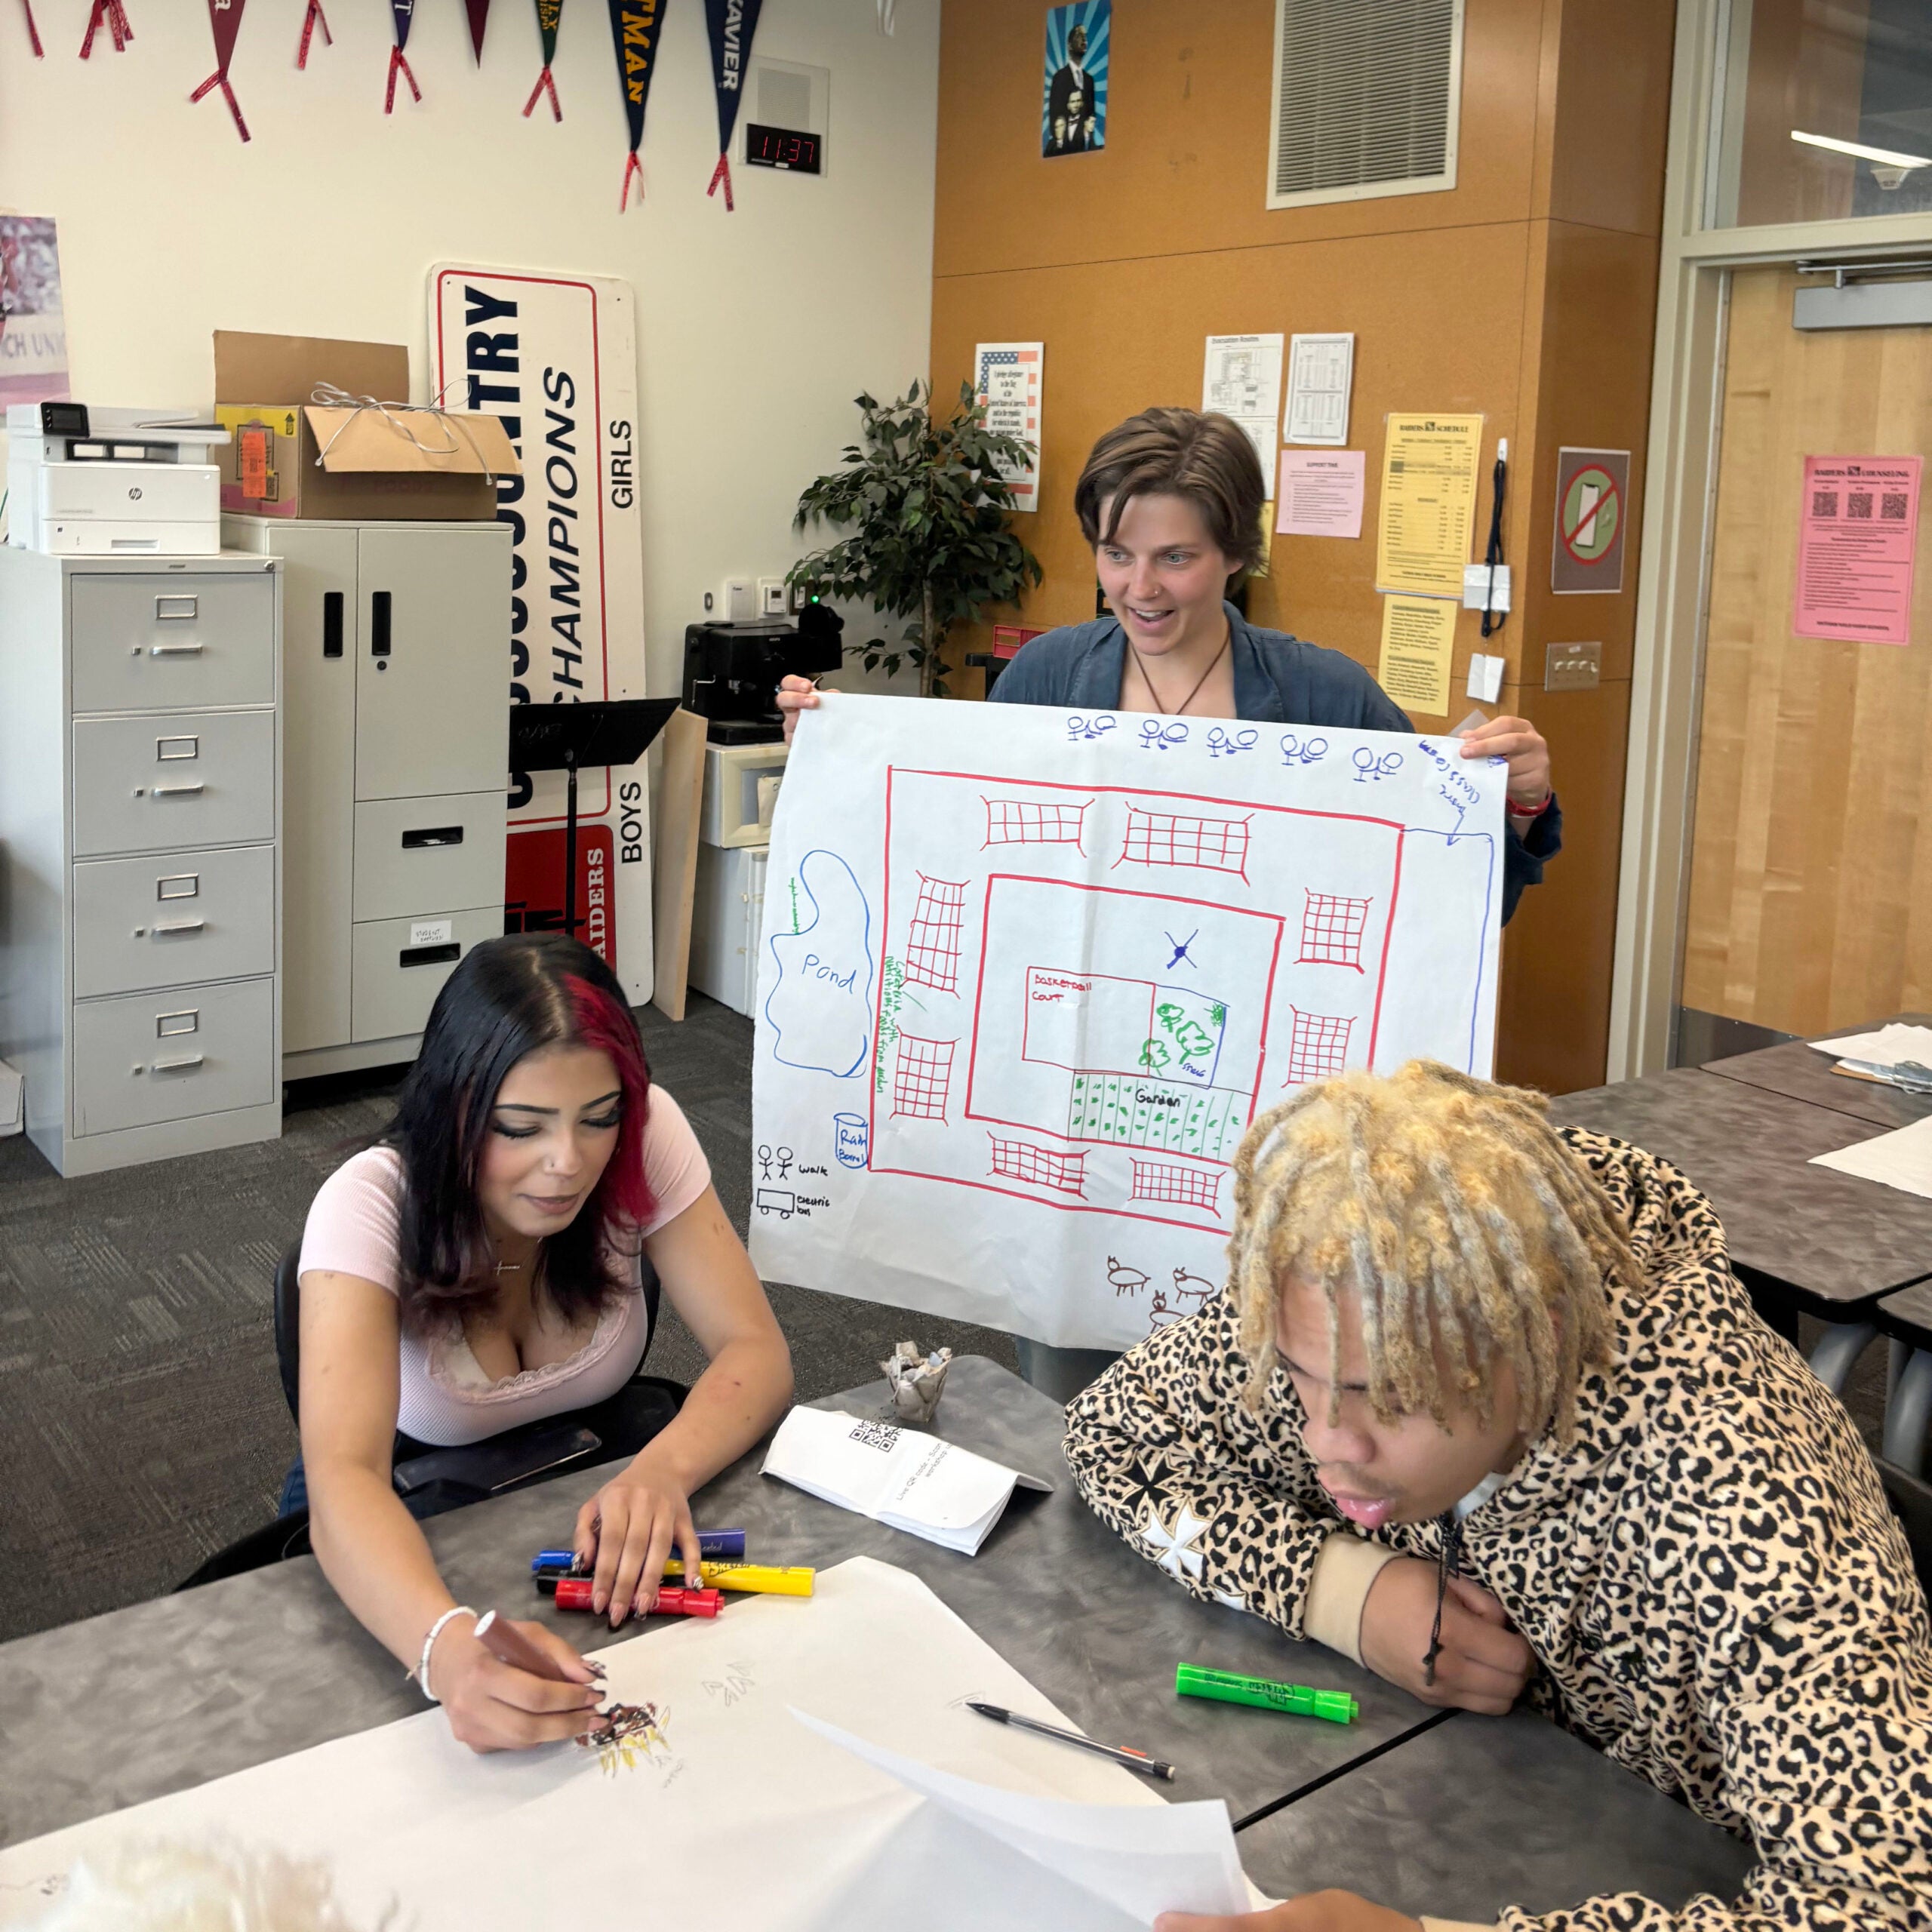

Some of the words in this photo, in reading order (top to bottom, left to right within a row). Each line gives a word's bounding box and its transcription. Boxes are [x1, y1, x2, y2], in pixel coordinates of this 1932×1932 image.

[762, 136, 814, 164] 11:37
[608, 420, 633, 509] GIRLS
[620, 782, 643, 863] BOYS
[587, 848, 605, 960] AIDERS
[802, 954, 857, 995] Pond
[1135, 1088, 1180, 1107] Garden
[906, 1476, 918, 1487] QR
